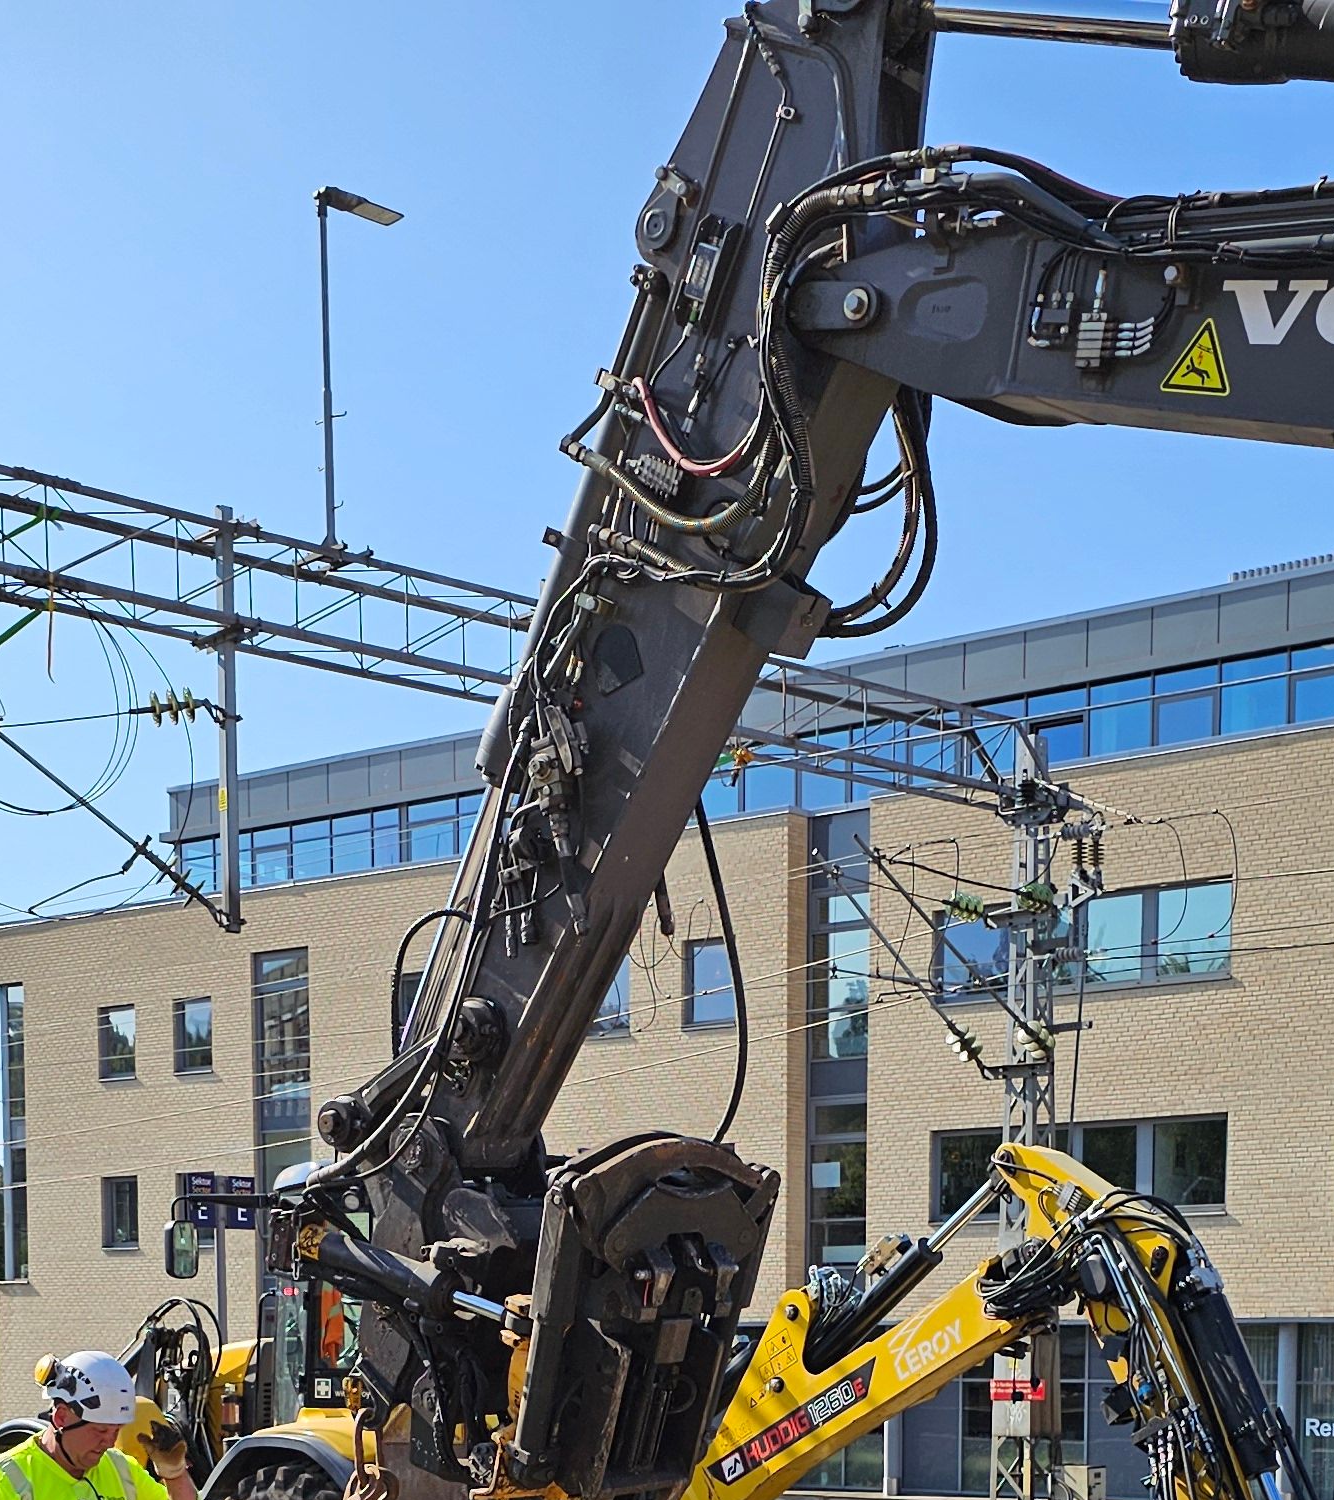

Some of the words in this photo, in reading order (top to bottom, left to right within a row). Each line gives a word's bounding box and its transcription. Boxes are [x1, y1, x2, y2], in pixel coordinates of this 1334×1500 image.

[192, 1177, 212, 1186] Sektor
[232, 1179, 252, 1188] Sektor
[894, 1318, 962, 1381] LEROY
[743, 1409, 812, 1466] HUDDIG
